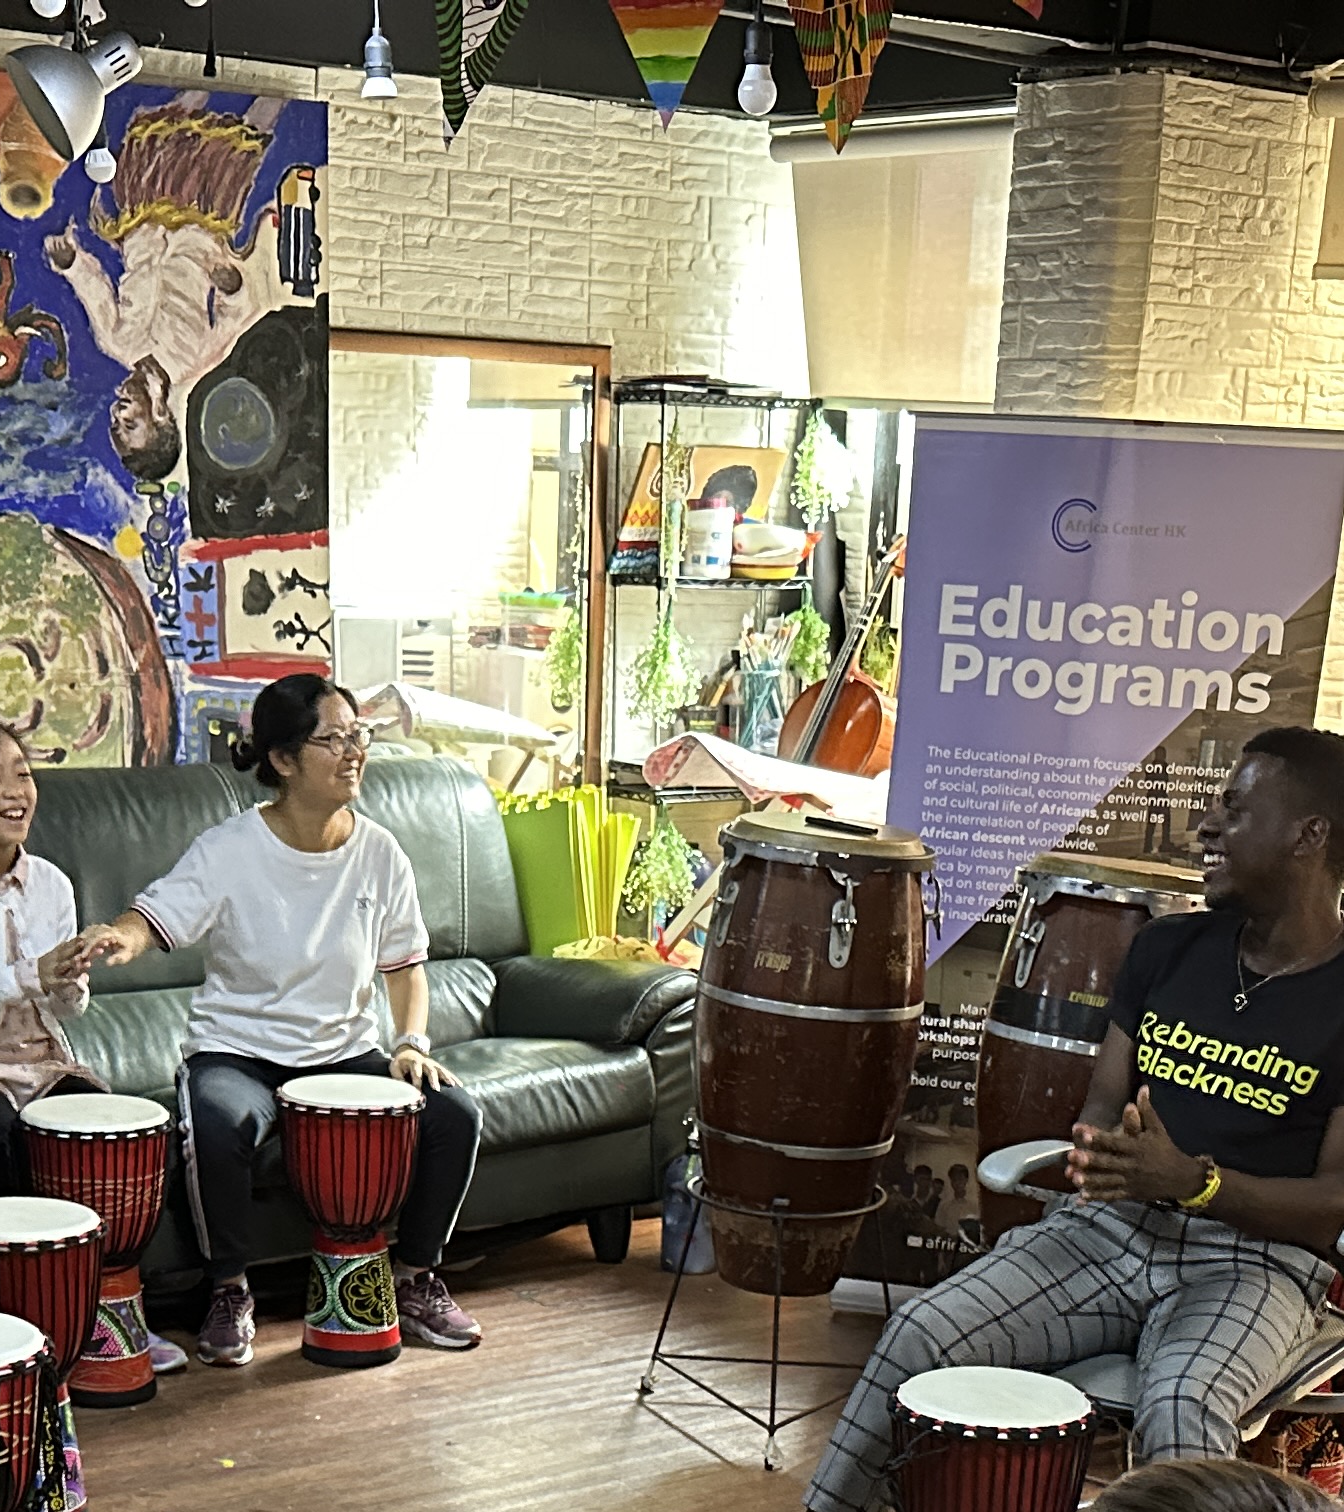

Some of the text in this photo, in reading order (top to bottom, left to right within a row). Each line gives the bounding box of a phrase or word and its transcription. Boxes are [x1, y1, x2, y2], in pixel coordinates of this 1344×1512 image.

[1064, 517, 1188, 539] Africa Center HK
[937, 583, 1285, 656] Education
[939, 642, 1272, 716] Programs
[928, 745, 951, 759] The
[954, 747, 1030, 765] Educational
[1033, 752, 1090, 770] Program
[1093, 756, 1142, 772] focuses
[1145, 763, 1163, 774] on
[925, 764, 1222, 796] an understanding about the rich complexities
[924, 778, 1207, 812] of social, political, economic, environmental,
[921, 810, 1110, 836] the interrelation of peoples of
[922, 795, 1165, 824] and cultural life of Africans, as well as
[919, 826, 1098, 852] African descent worldwide.
[970, 846, 1004, 861] ideas
[1007, 848, 1036, 863] held
[956, 878, 972, 890] on
[958, 861, 972, 876] by
[976, 864, 1012, 880] many
[955, 892, 976, 906] are
[1137, 1011, 1320, 1095] Rebranding
[910, 1073, 938, 1088] hold
[940, 1078, 962, 1090] our
[1137, 1044, 1290, 1116] Blackness
